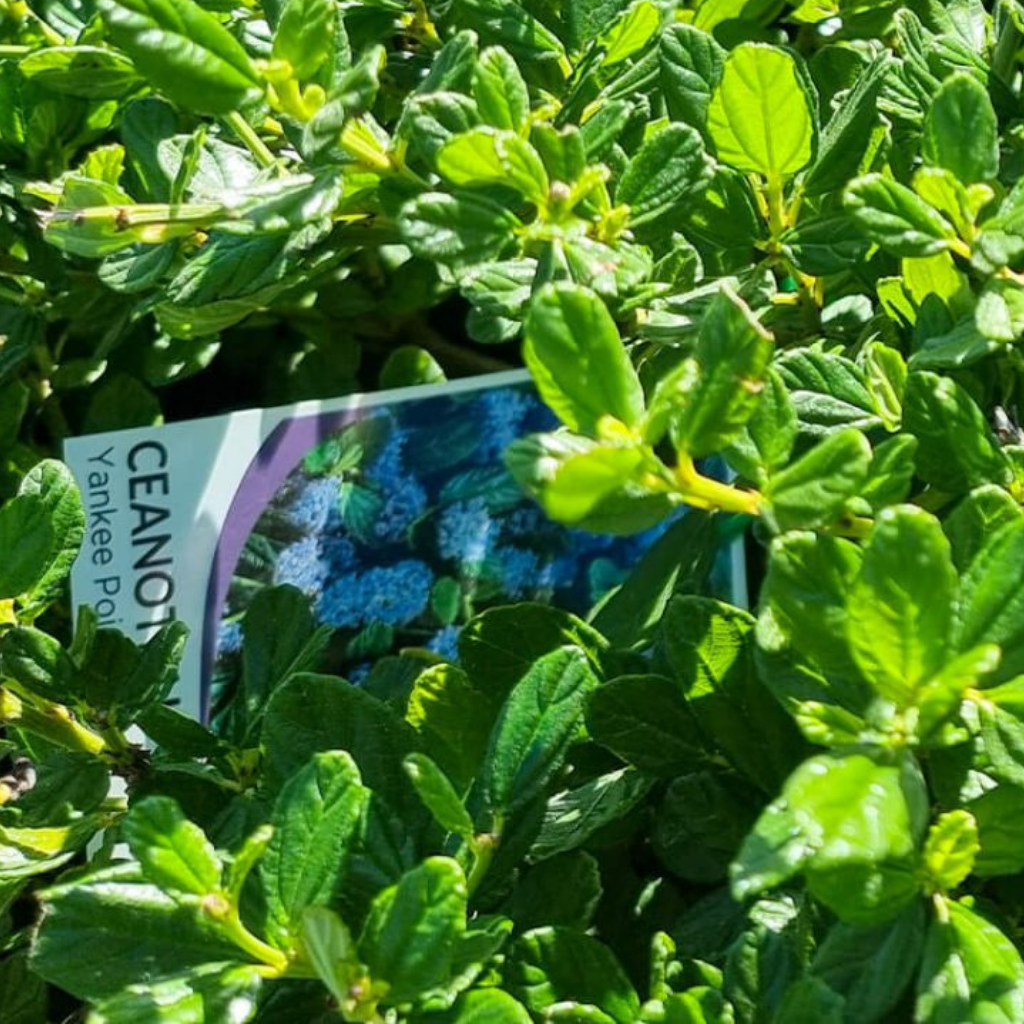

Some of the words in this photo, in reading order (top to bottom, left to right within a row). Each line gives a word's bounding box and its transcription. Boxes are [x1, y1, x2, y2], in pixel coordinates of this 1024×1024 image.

[87, 446, 118, 566] Yankee
[93, 576, 123, 627] Poi
[127, 440, 181, 705] CEANOT
